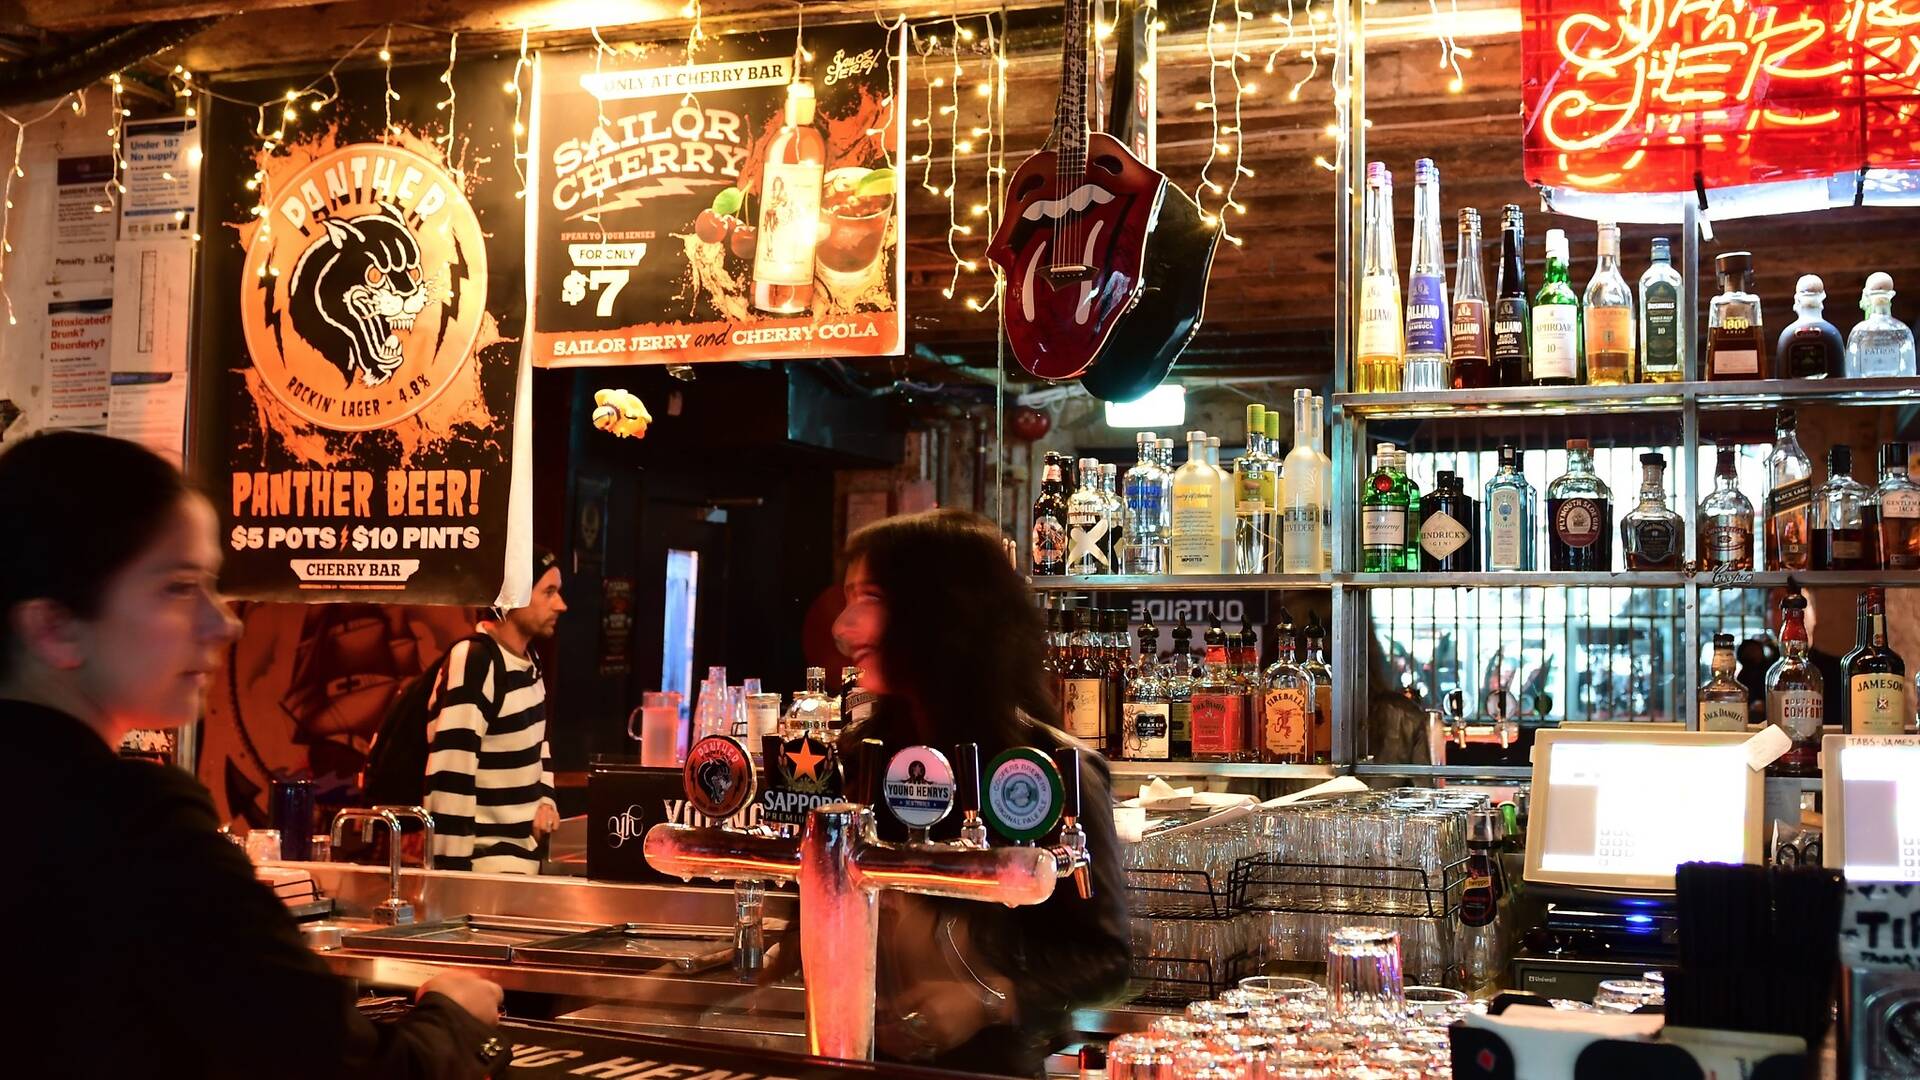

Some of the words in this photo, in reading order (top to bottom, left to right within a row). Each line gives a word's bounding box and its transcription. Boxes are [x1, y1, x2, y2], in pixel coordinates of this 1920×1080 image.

[1066, 0, 1081, 49] Sto
[604, 76, 646, 92] ONLY
[651, 74, 674, 88] AT
[677, 67, 744, 87] CHERRY
[748, 64, 784, 79] BAR
[130, 141, 160, 150] Under
[163, 139, 180, 148] 18?
[553, 105, 741, 178] SAILOR
[130, 154, 144, 162] No
[146, 151, 179, 162] supply
[552, 141, 751, 211] CHERRY
[280, 156, 448, 234] PANTHER
[561, 232, 588, 241] SPEAK
[589, 232, 601, 240] TO
[602, 231, 625, 241] YOUR
[625, 230, 656, 239] SENSES
[580, 249, 602, 259] FOR
[606, 249, 636, 259] ONLY
[55, 258, 86, 267] Penalty
[562, 270, 630, 317] $7
[1407, 304, 1440, 322] GALLIANO
[52, 315, 112, 328] Intoxicated?
[1494, 321, 1523, 336] GALLIANO
[1536, 322, 1575, 333] APHROAI
[1722, 319, 1749, 330] 1800
[51, 328, 85, 340] Drunk?
[1452, 322, 1480, 337] GALLIANO
[1657, 327, 1666, 335] 10
[51, 338, 106, 352] Disorderly?
[553, 340, 627, 357] SAILOR
[628, 333, 692, 353] JERRY
[694, 324, 733, 348] and
[732, 327, 813, 348] CHERRY
[817, 321, 879, 342] COLA
[1546, 344, 1556, 353] 10
[285, 375, 337, 414] ROCKIN'
[341, 400, 381, 417] LAGER
[398, 374, 431, 401] 4.8%
[231, 470, 374, 518] PANTHER
[386, 468, 482, 518] BEER!
[1558, 499, 1582, 531] PLYMOUTH
[1583, 501, 1598, 518] SLOE
[1592, 517, 1600, 531] GIN
[231, 525, 264, 551] $5
[267, 526, 337, 550] POTS
[352, 525, 398, 551] $10
[402, 526, 480, 550] PINTS
[1420, 531, 1466, 540] ENDRICK'S
[306, 563, 366, 577] CHERRY
[368, 563, 401, 577] BAR
[1857, 679, 1903, 692] JAMESON
[1266, 693, 1304, 707] FIREBALL
[1704, 710, 1719, 722] JACK
[1784, 706, 1822, 719] COMFORT
[993, 763, 1019, 792] COOPERS
[1021, 763, 1047, 793] BREWERY
[888, 784, 914, 797] YOUNG
[916, 785, 949, 799] HENRYS
[663, 799, 765, 829] YONG
[765, 811, 805, 823] PREMIU
